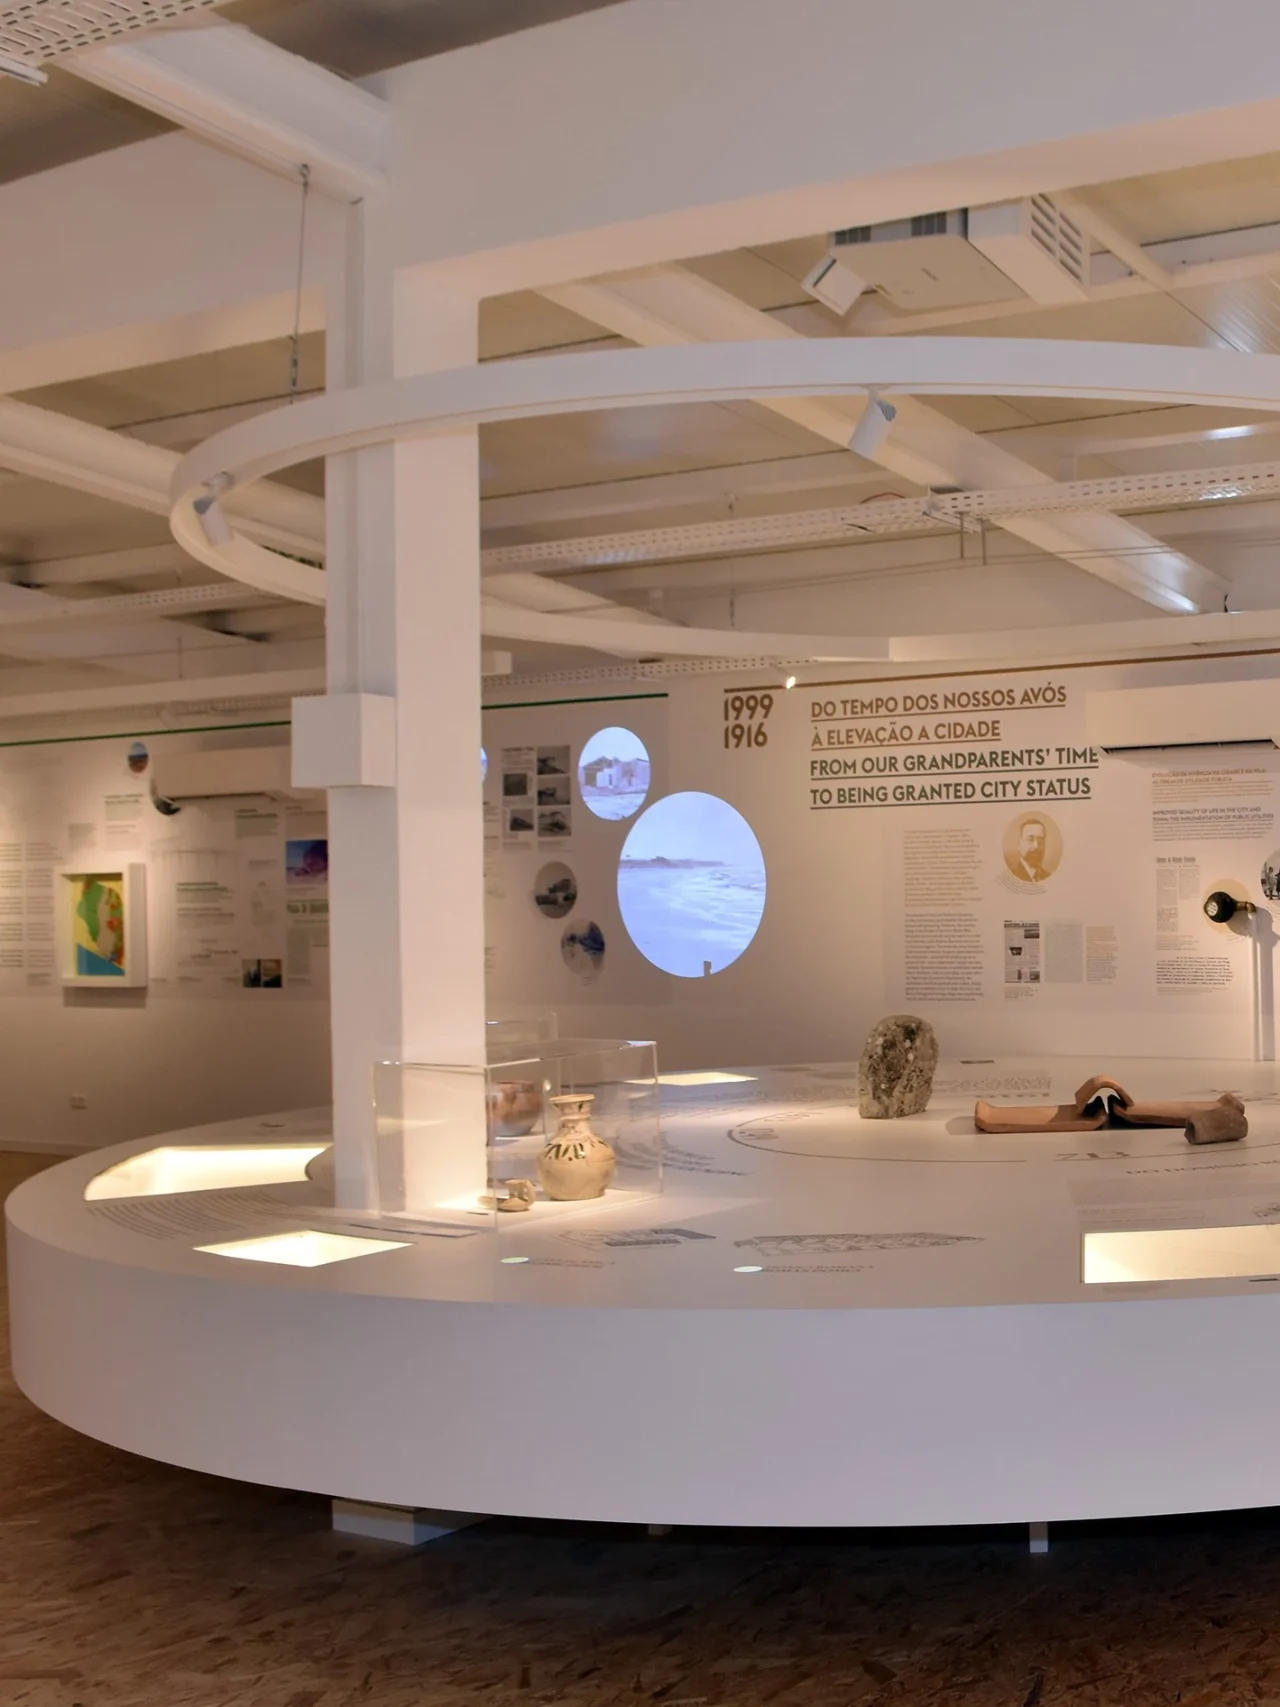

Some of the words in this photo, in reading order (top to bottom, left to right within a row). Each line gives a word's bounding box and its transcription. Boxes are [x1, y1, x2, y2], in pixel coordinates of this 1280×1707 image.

[724, 694, 774, 721] 1999
[811, 701, 836, 718] DO
[841, 697, 898, 716] TEMPO
[903, 694, 939, 712] DOS
[944, 688, 1016, 709] NOSSOS
[1020, 682, 1067, 705] AVÓS
[724, 722, 768, 749] 1916
[811, 726, 823, 747] À
[827, 721, 913, 745] ELEVAÇÃO
[917, 725, 930, 741] A
[934, 720, 1000, 739] CIDADE
[810, 758, 857, 776] FROM
[862, 756, 899, 774] OUR
[903, 748, 1050, 772] GRANDPARENTS'
[1055, 746, 1099, 765] TIME
[810, 788, 832, 805] TO
[837, 786, 888, 804] BEING
[893, 781, 976, 802] GRANTED
[980, 780, 1022, 798] CITY
[1026, 777, 1091, 797] STATUS
